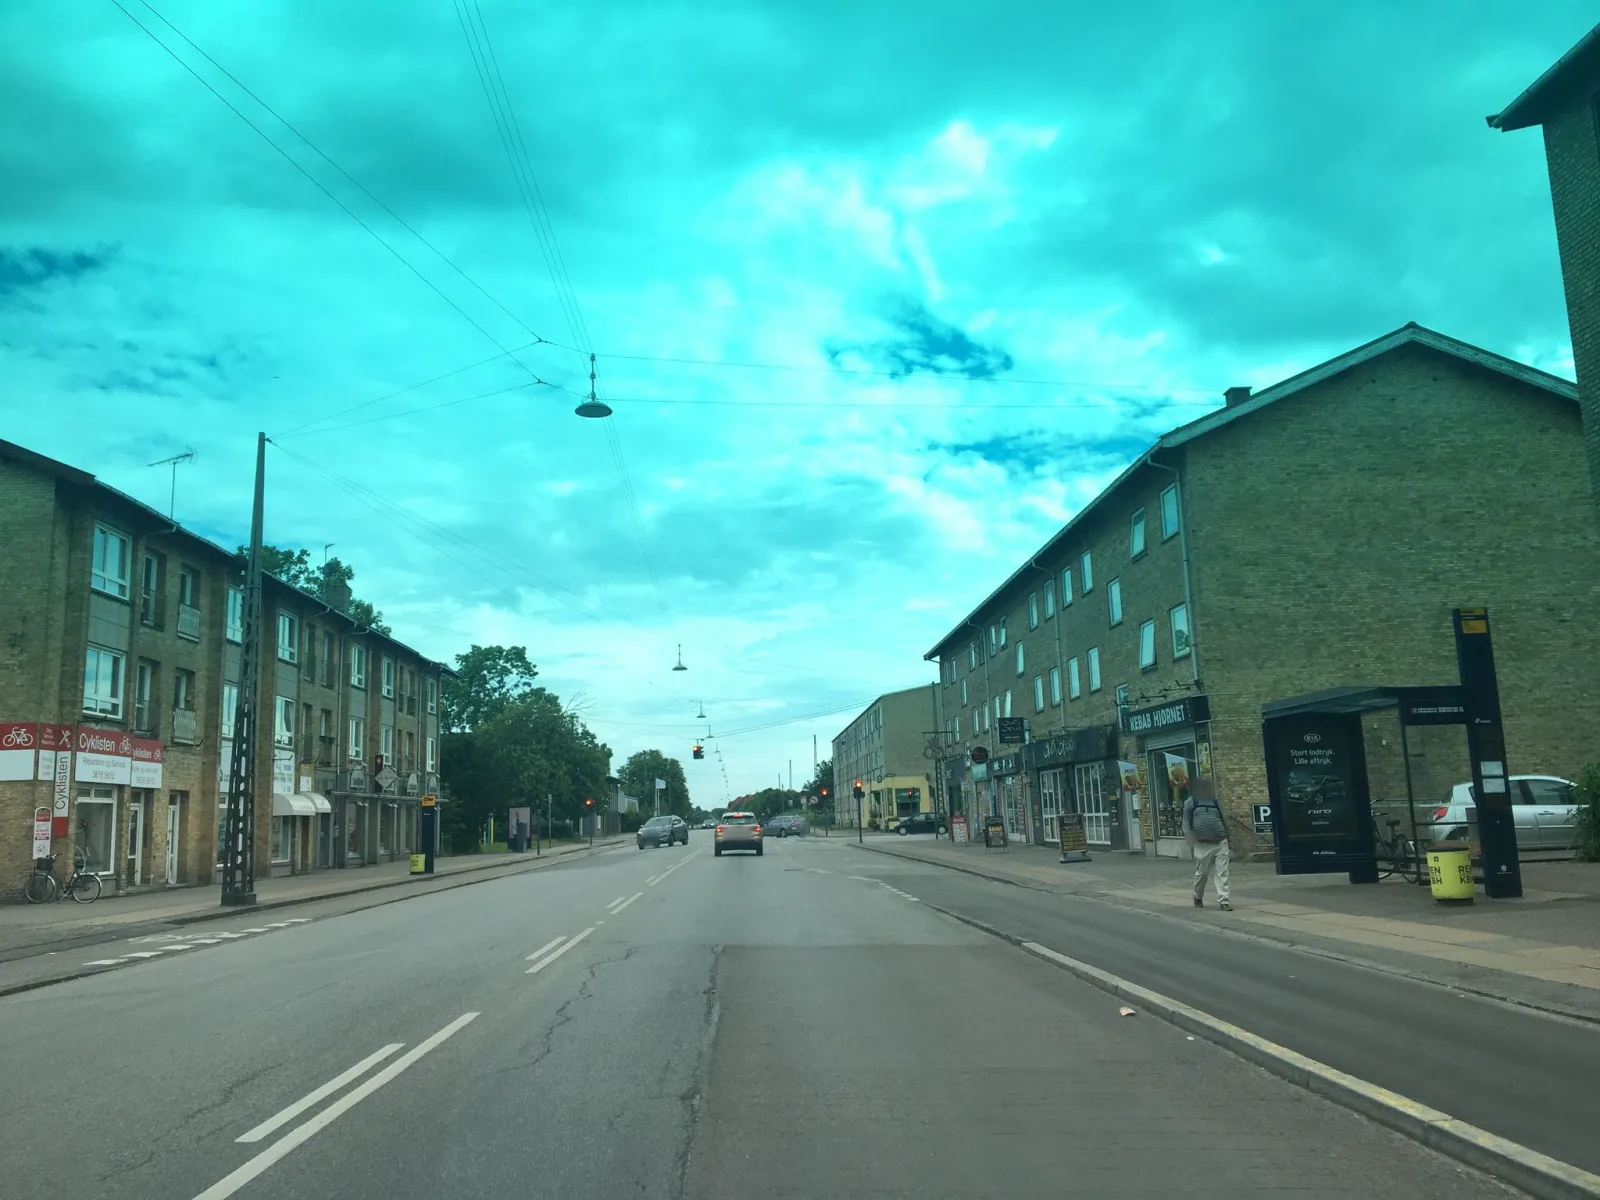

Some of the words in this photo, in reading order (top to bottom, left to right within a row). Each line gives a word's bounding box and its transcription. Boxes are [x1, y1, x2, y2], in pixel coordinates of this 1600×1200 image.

[1130, 713, 1152, 731] KEBAB
[1153, 705, 1185, 727] HJØRNET
[80, 733, 115, 752] Cyklisten
[132, 748, 152, 759] yklisten
[54, 757, 68, 810] Cyklisten
[1260, 806, 1271, 821] P
[1430, 866, 1441, 874] EN
[1431, 876, 1442, 885] BH
